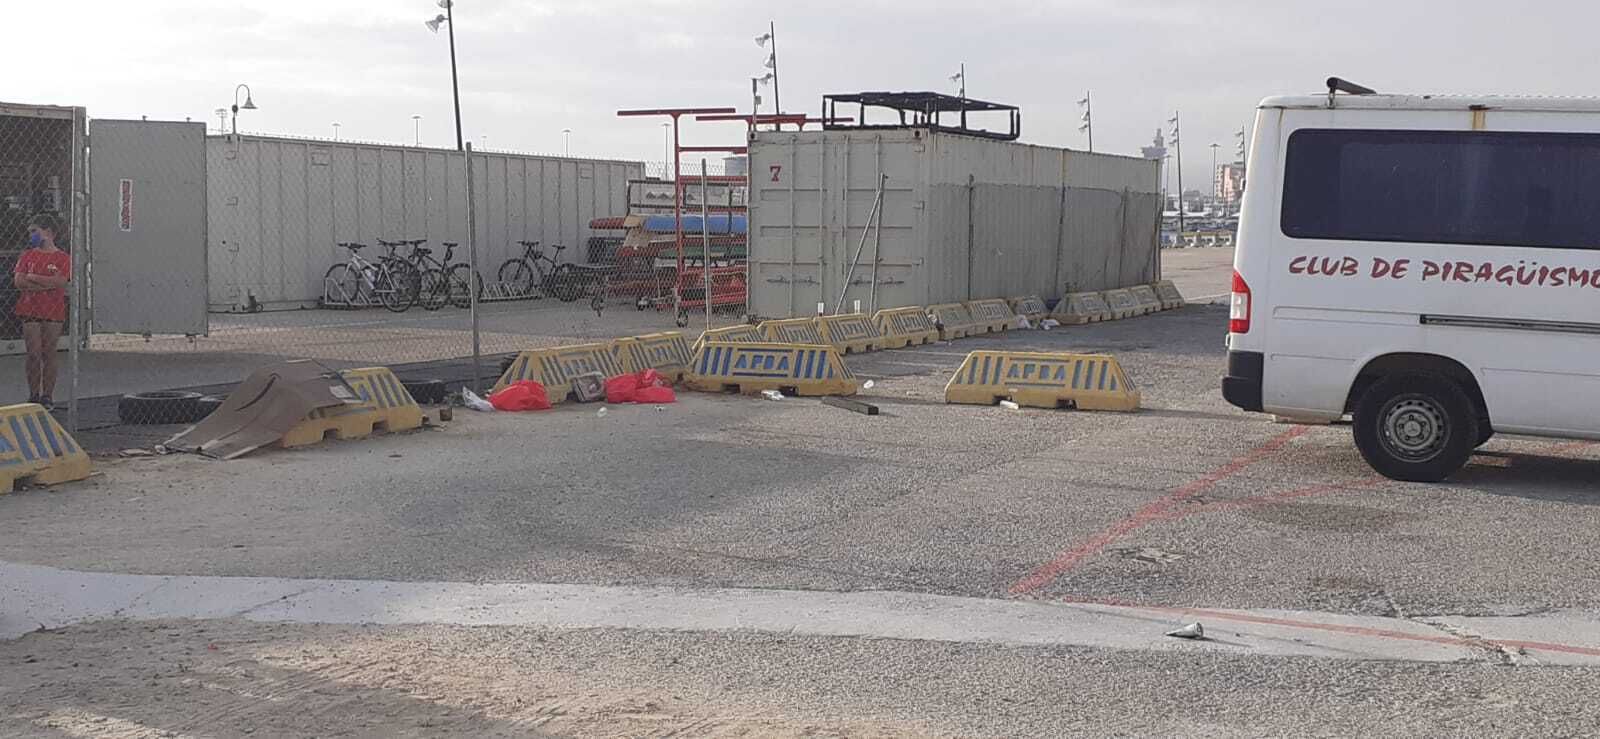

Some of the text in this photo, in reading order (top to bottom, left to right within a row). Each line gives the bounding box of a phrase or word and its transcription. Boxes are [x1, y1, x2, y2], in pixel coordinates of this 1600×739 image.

[769, 165, 782, 182] 7
[1288, 255, 1361, 277] CLUB
[1369, 257, 1411, 279] DE
